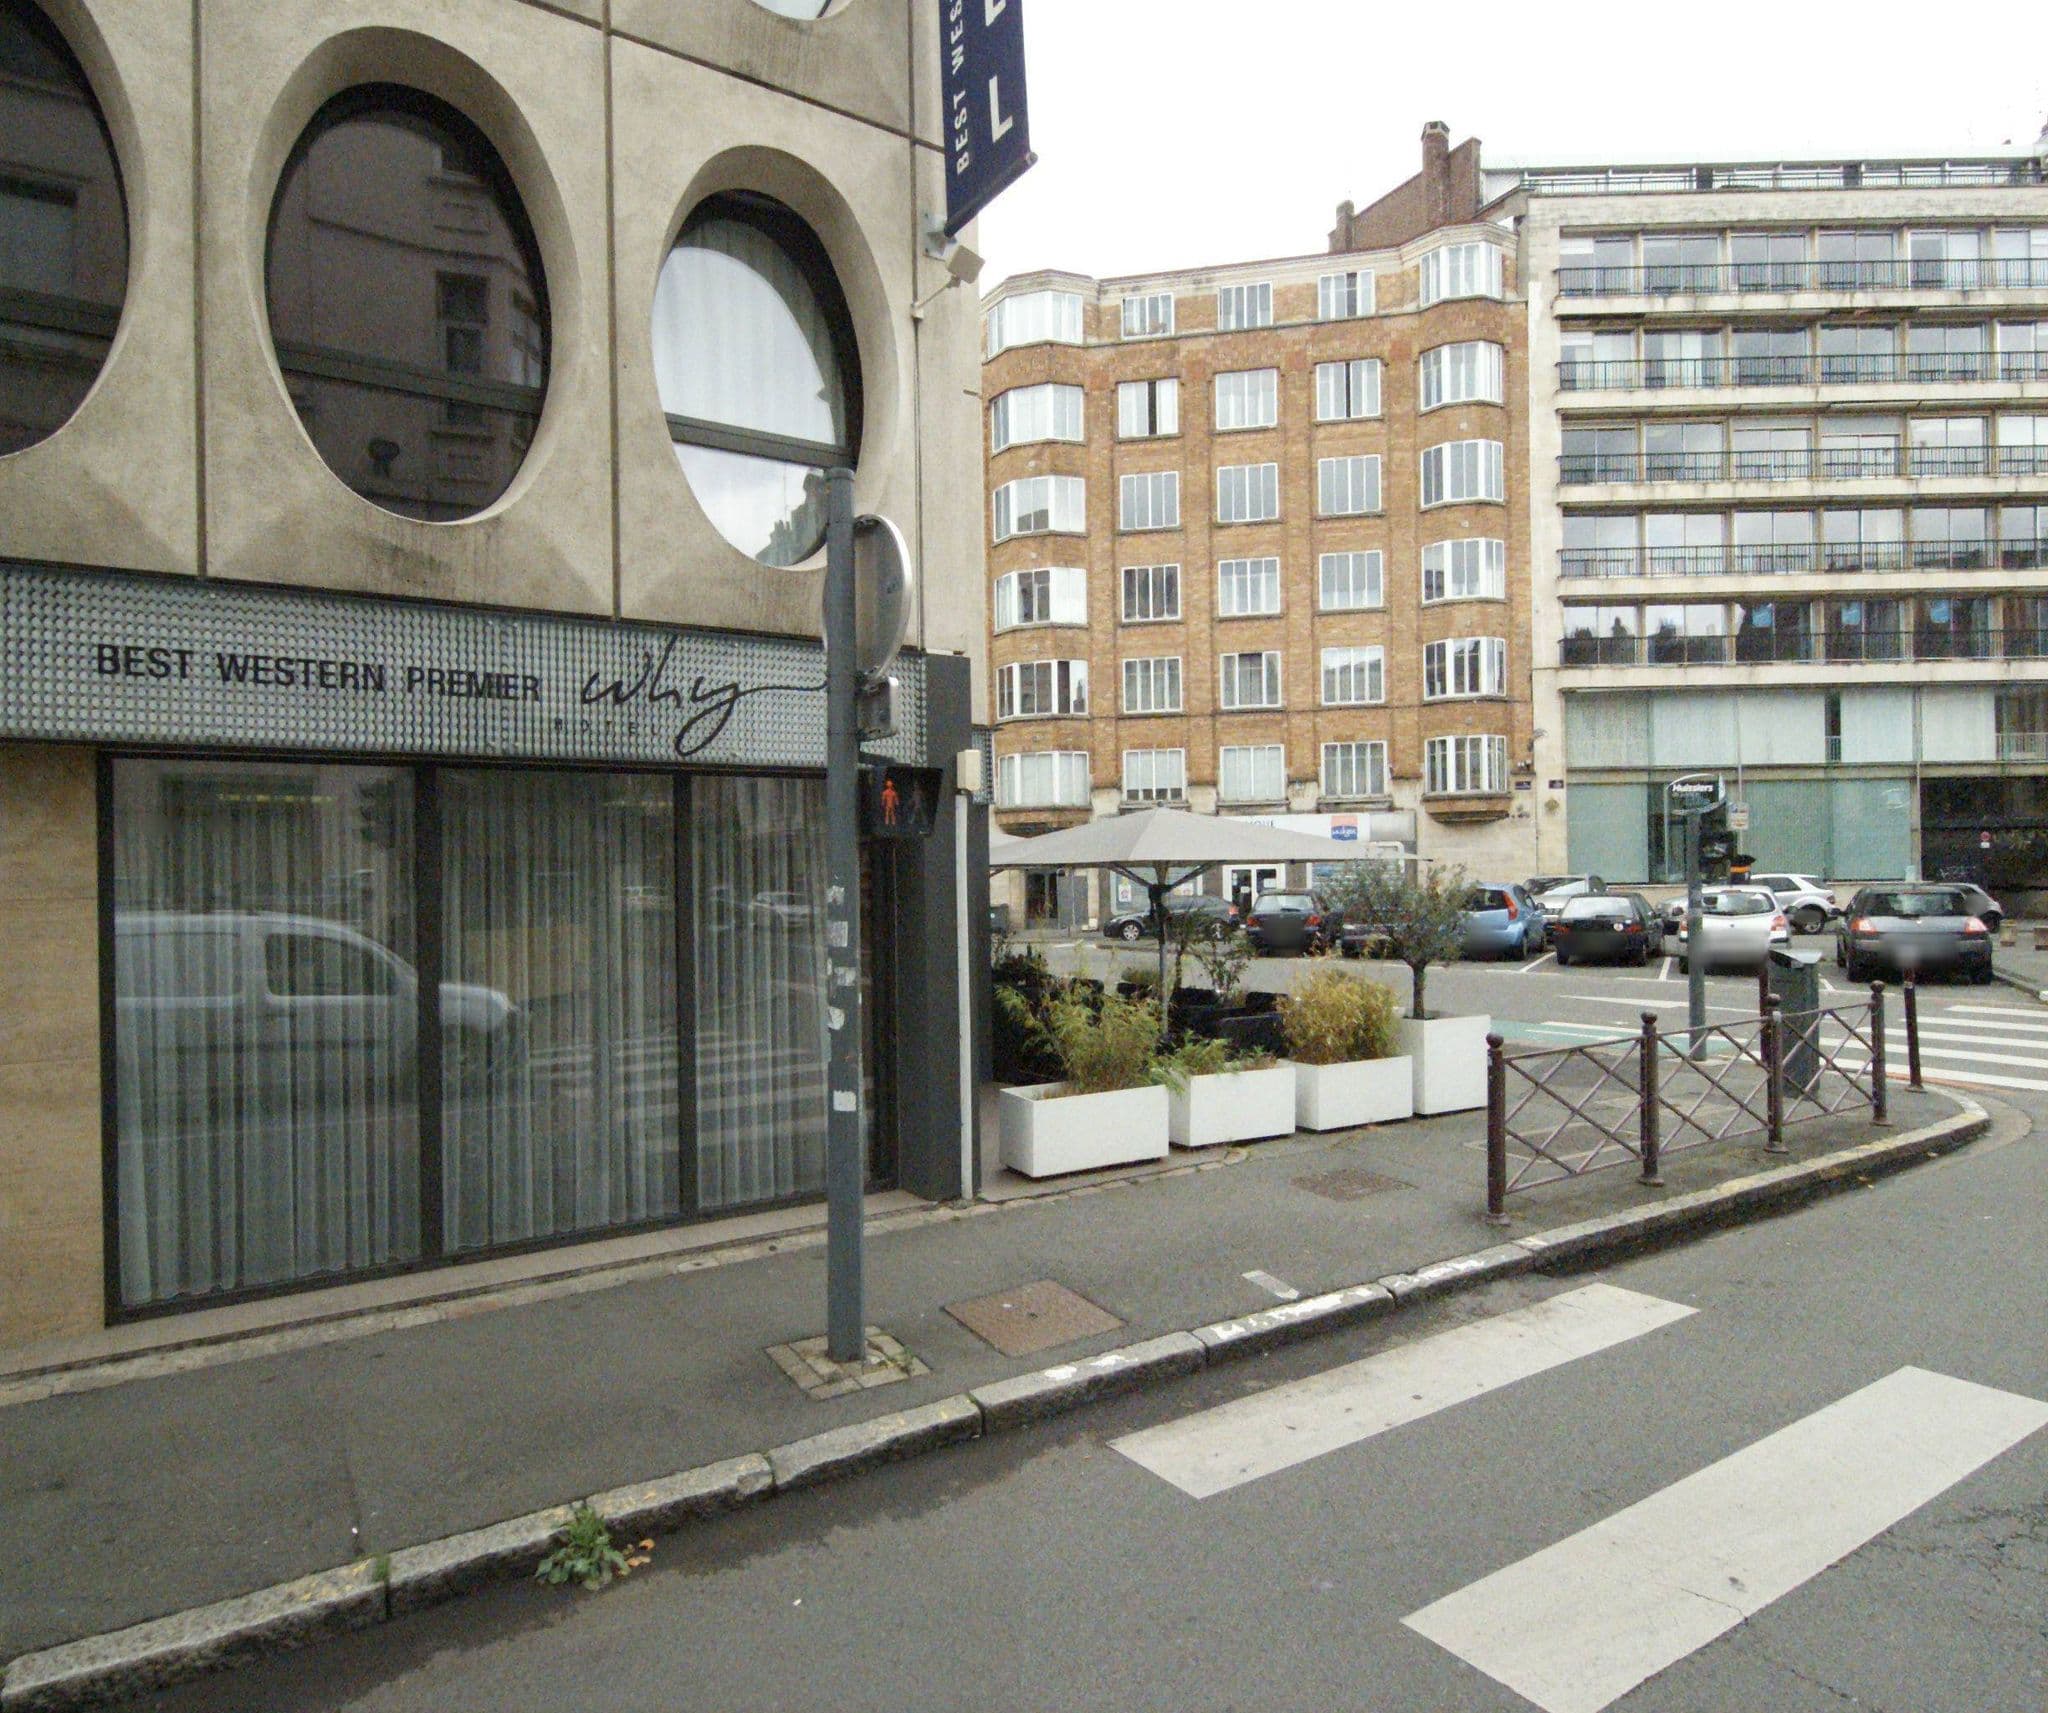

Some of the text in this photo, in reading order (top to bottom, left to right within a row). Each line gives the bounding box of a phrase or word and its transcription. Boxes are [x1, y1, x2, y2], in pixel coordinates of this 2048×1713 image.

[954, 90, 970, 175] BEST
[97, 644, 541, 702] BEST WESTERN PREMIER
